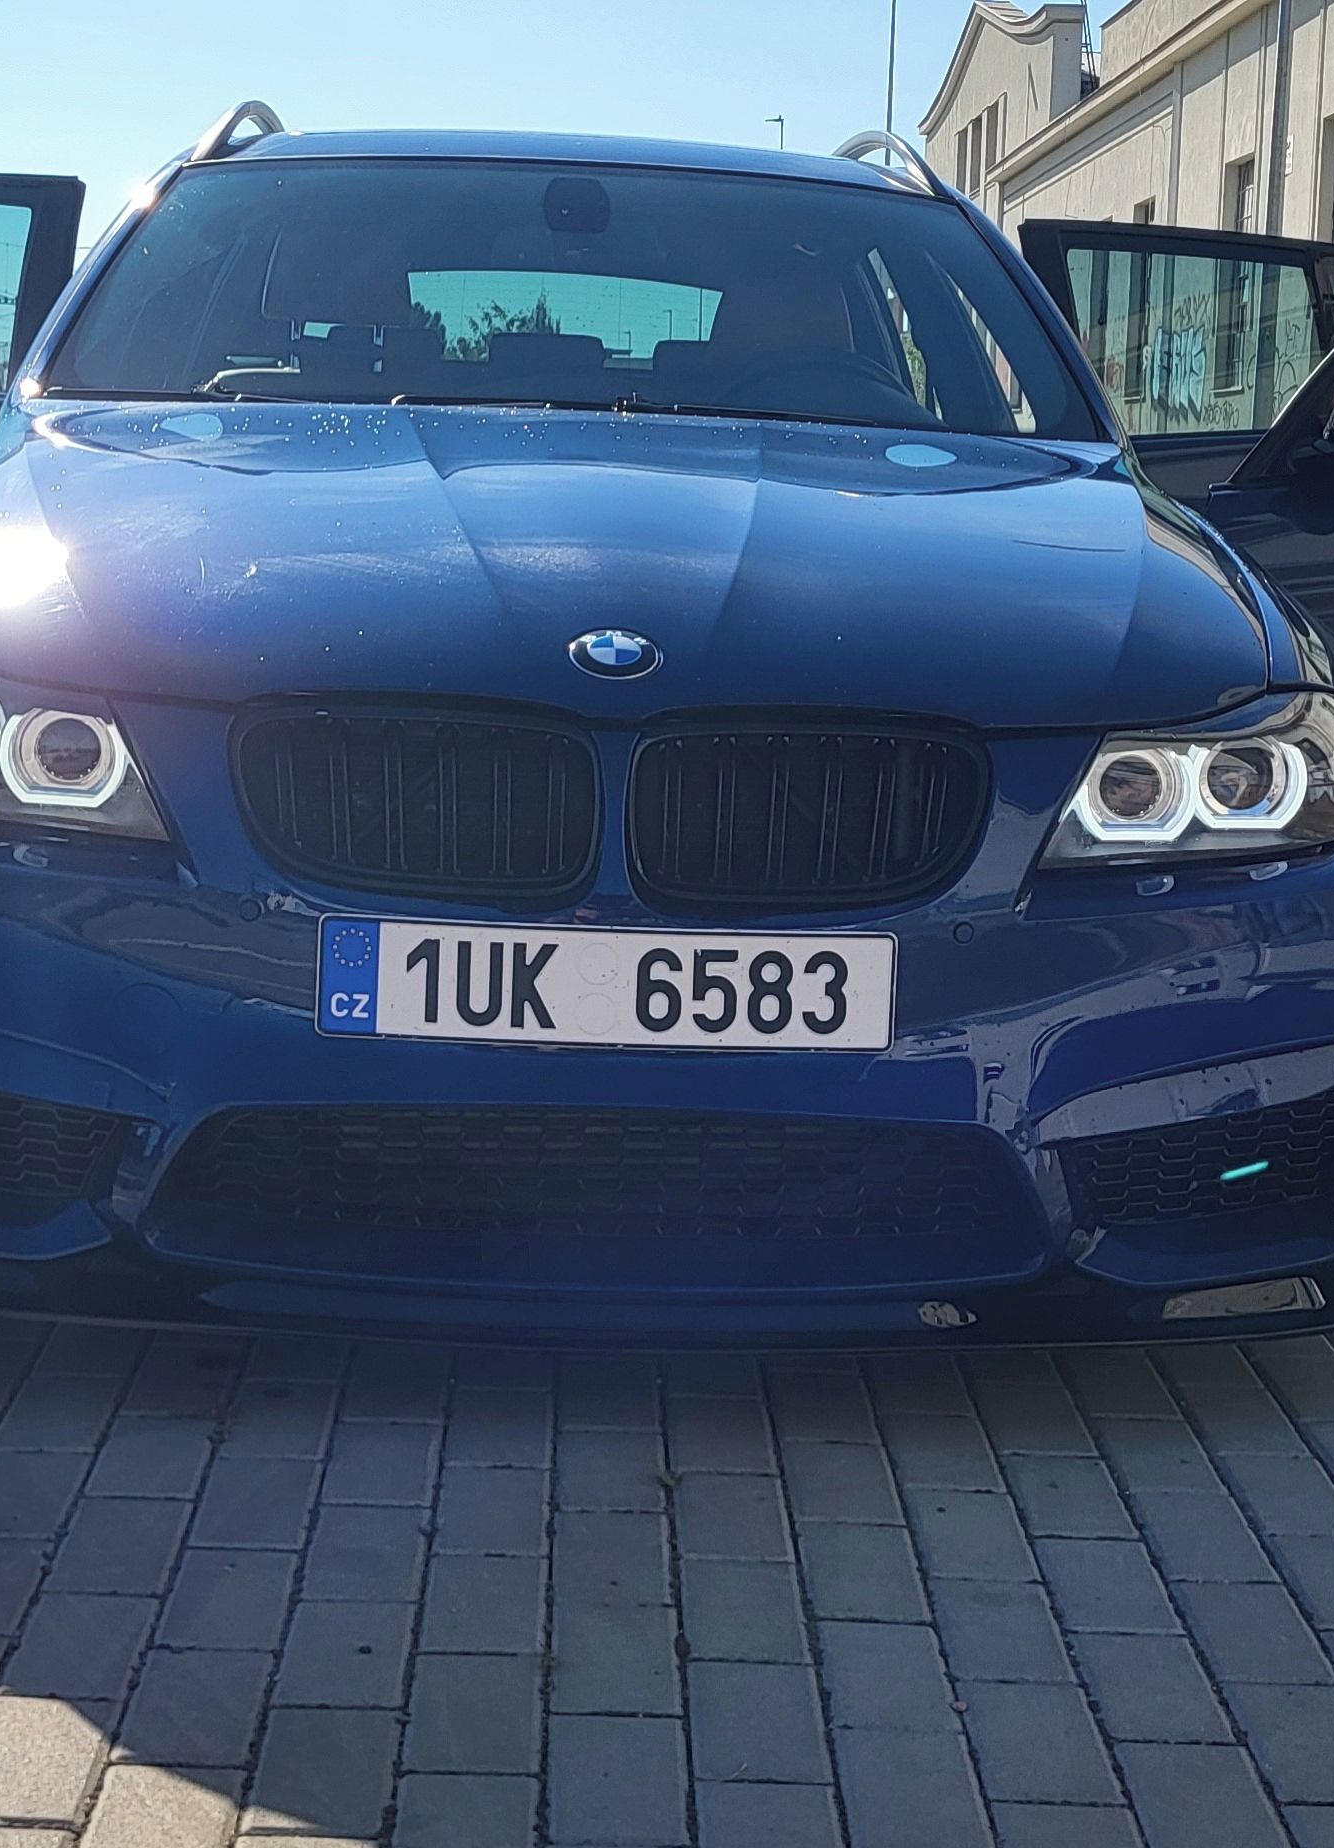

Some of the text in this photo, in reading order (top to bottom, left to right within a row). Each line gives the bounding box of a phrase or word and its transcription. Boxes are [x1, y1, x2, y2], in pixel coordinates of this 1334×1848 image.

[329, 991, 370, 1019] CZ
[405, 937, 849, 1034] 1UK 6583
